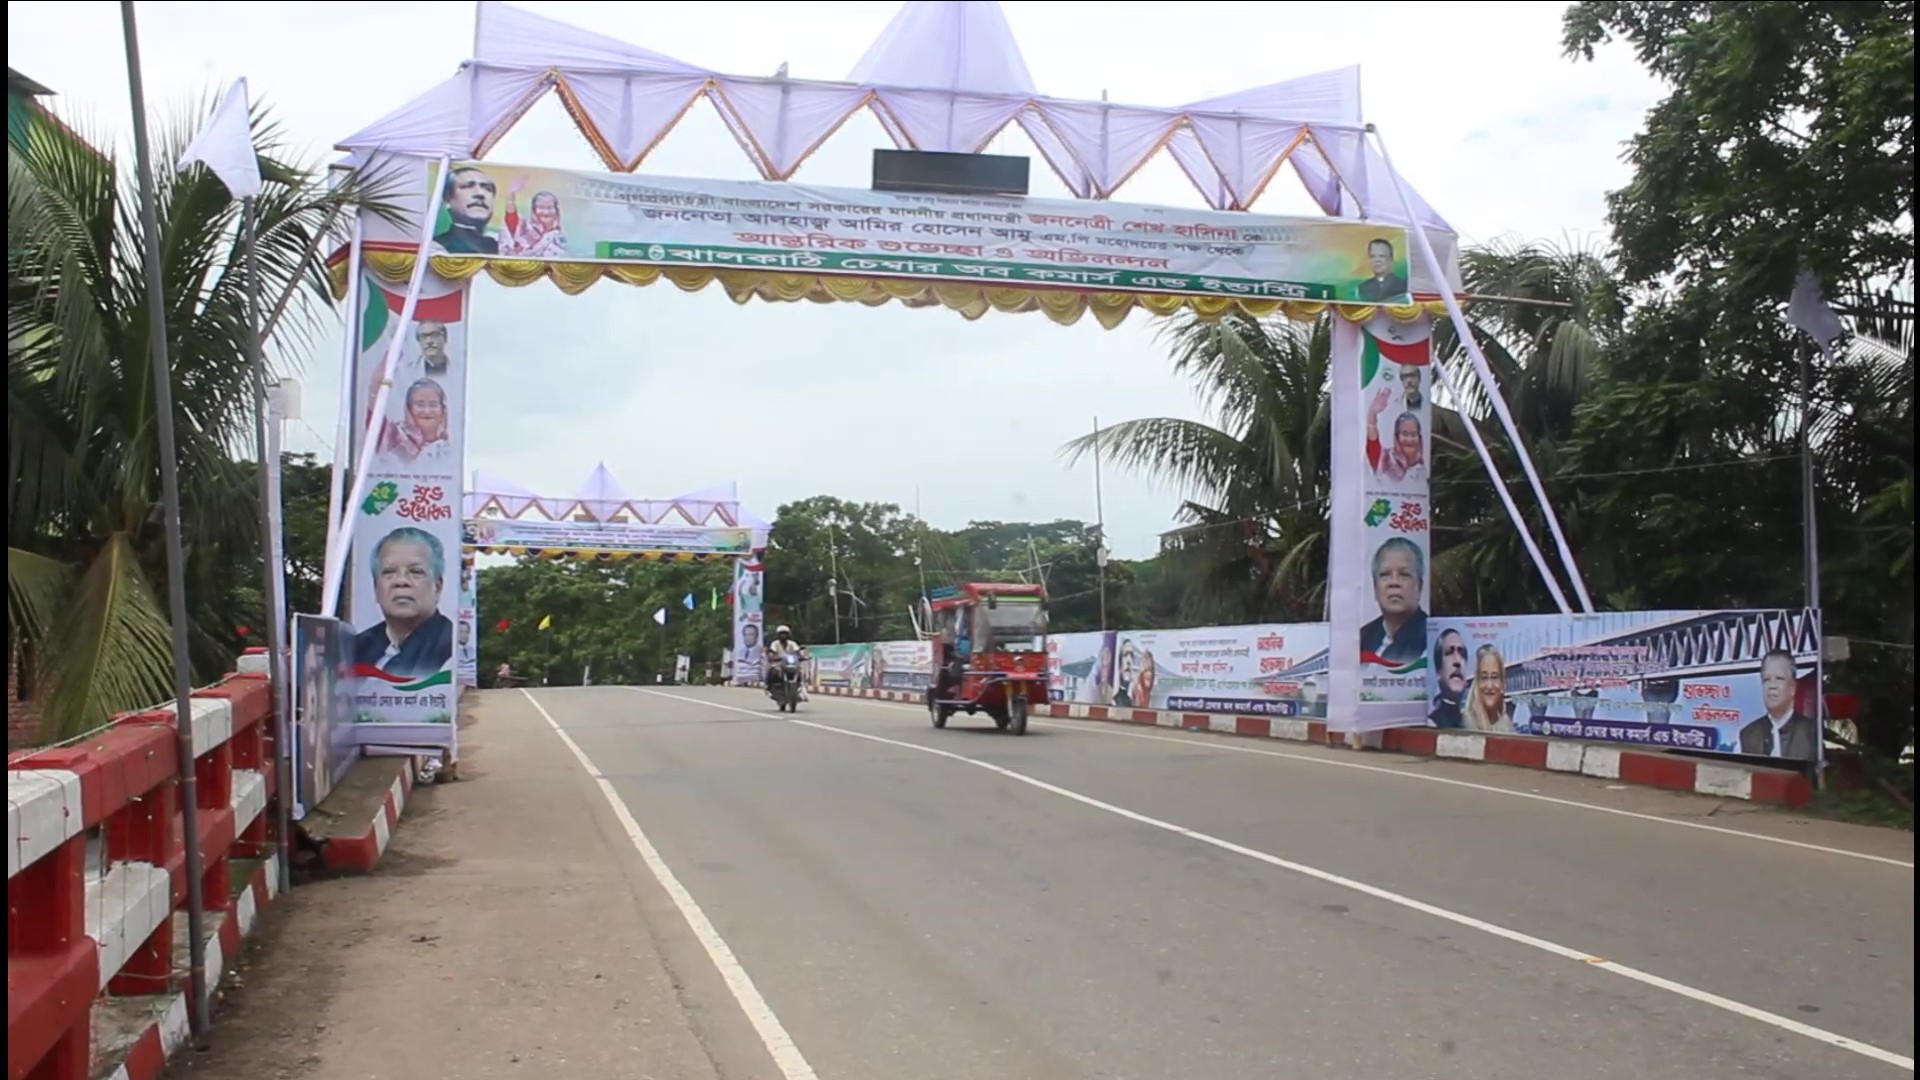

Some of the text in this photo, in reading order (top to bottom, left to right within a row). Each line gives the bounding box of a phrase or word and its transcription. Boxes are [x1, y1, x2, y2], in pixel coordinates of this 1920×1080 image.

[643, 207, 733, 223] জননেতা
[838, 217, 904, 232] আমির
[912, 222, 982, 237] হোসেন
[989, 227, 1032, 242] আমু
[1096, 236, 1168, 249] মহোদয়ের
[1207, 244, 1245, 256] থেকে
[808, 202, 882, 215] সরকারের
[888, 206, 947, 219] মাননীয়
[1027, 212, 1114, 231] জননেত্রী
[1122, 220, 1167, 233] শেখ
[1173, 222, 1239, 242] হাসিনা
[733, 231, 1170, 269] আন্তরিক শুভেচ্ছা ও অভিনন্দন
[667, 247, 826, 267] ঝালকাঠি
[840, 256, 943, 274] চেম্বার
[952, 263, 1014, 278] অব
[1022, 267, 1122, 285] কমার্স
[412, 484, 444, 505] শুভ
[395, 498, 452, 522] উদ্বোধন
[1721, 685, 1730, 698] ও
[1692, 703, 1740, 721] অভিনন্দন
[1609, 727, 1625, 739] অব
[1626, 725, 1652, 741] কমার্স
